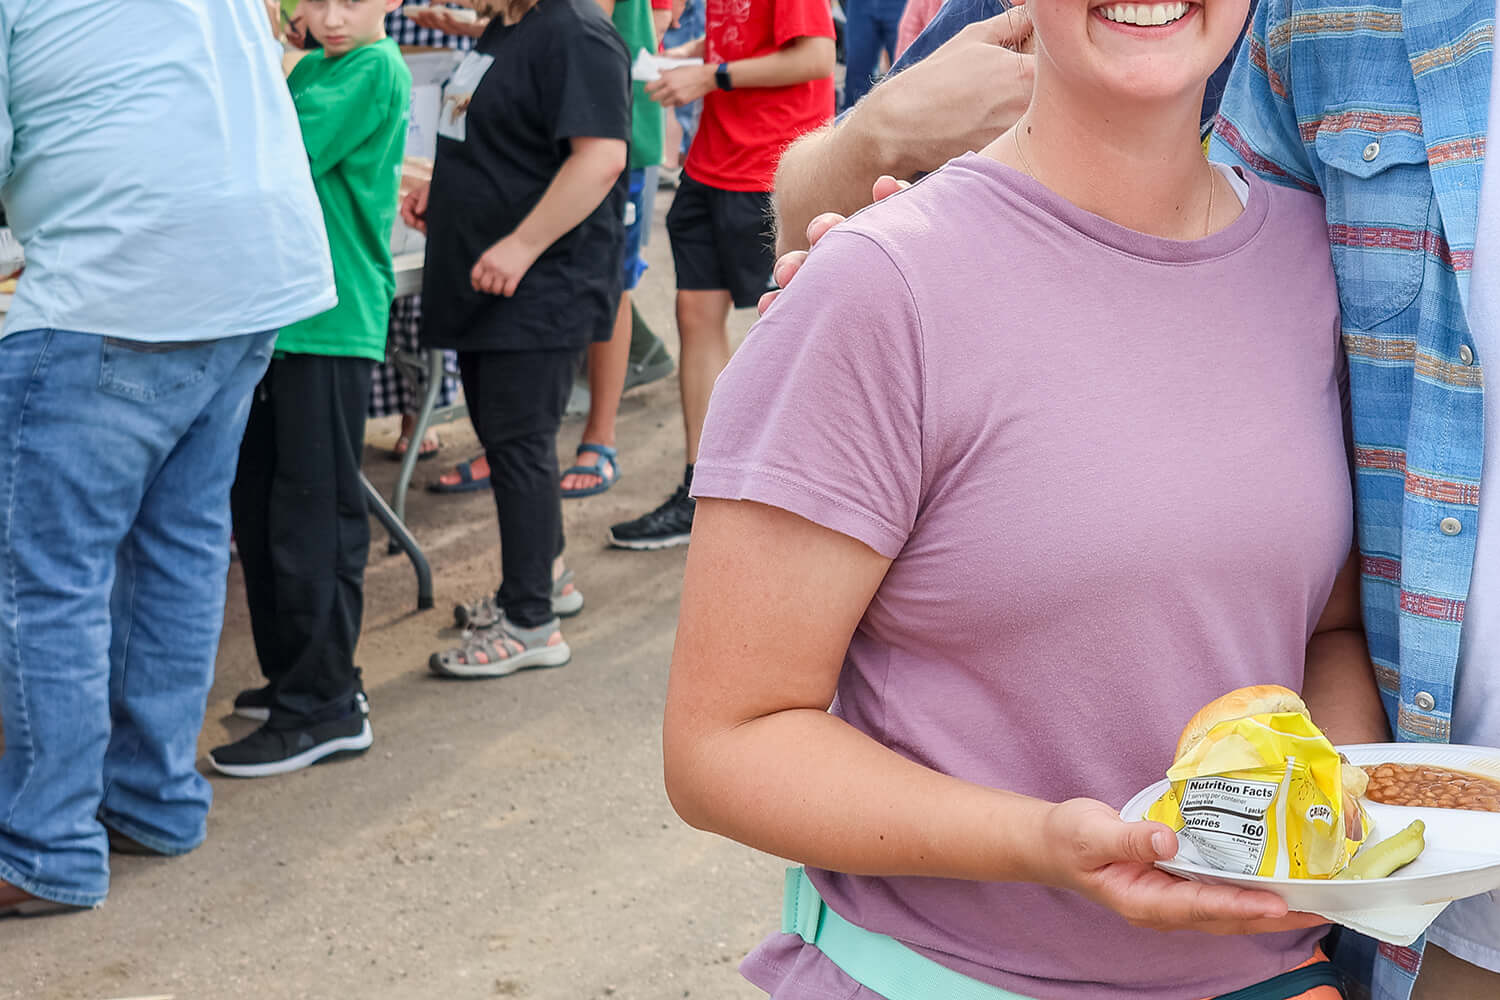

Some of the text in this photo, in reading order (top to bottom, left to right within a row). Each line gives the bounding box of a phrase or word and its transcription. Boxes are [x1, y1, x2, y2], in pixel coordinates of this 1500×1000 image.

[1189, 781, 1273, 798] Nutrition Facts
[1309, 806, 1331, 819] CRISPY
[1241, 823, 1264, 837] 160
